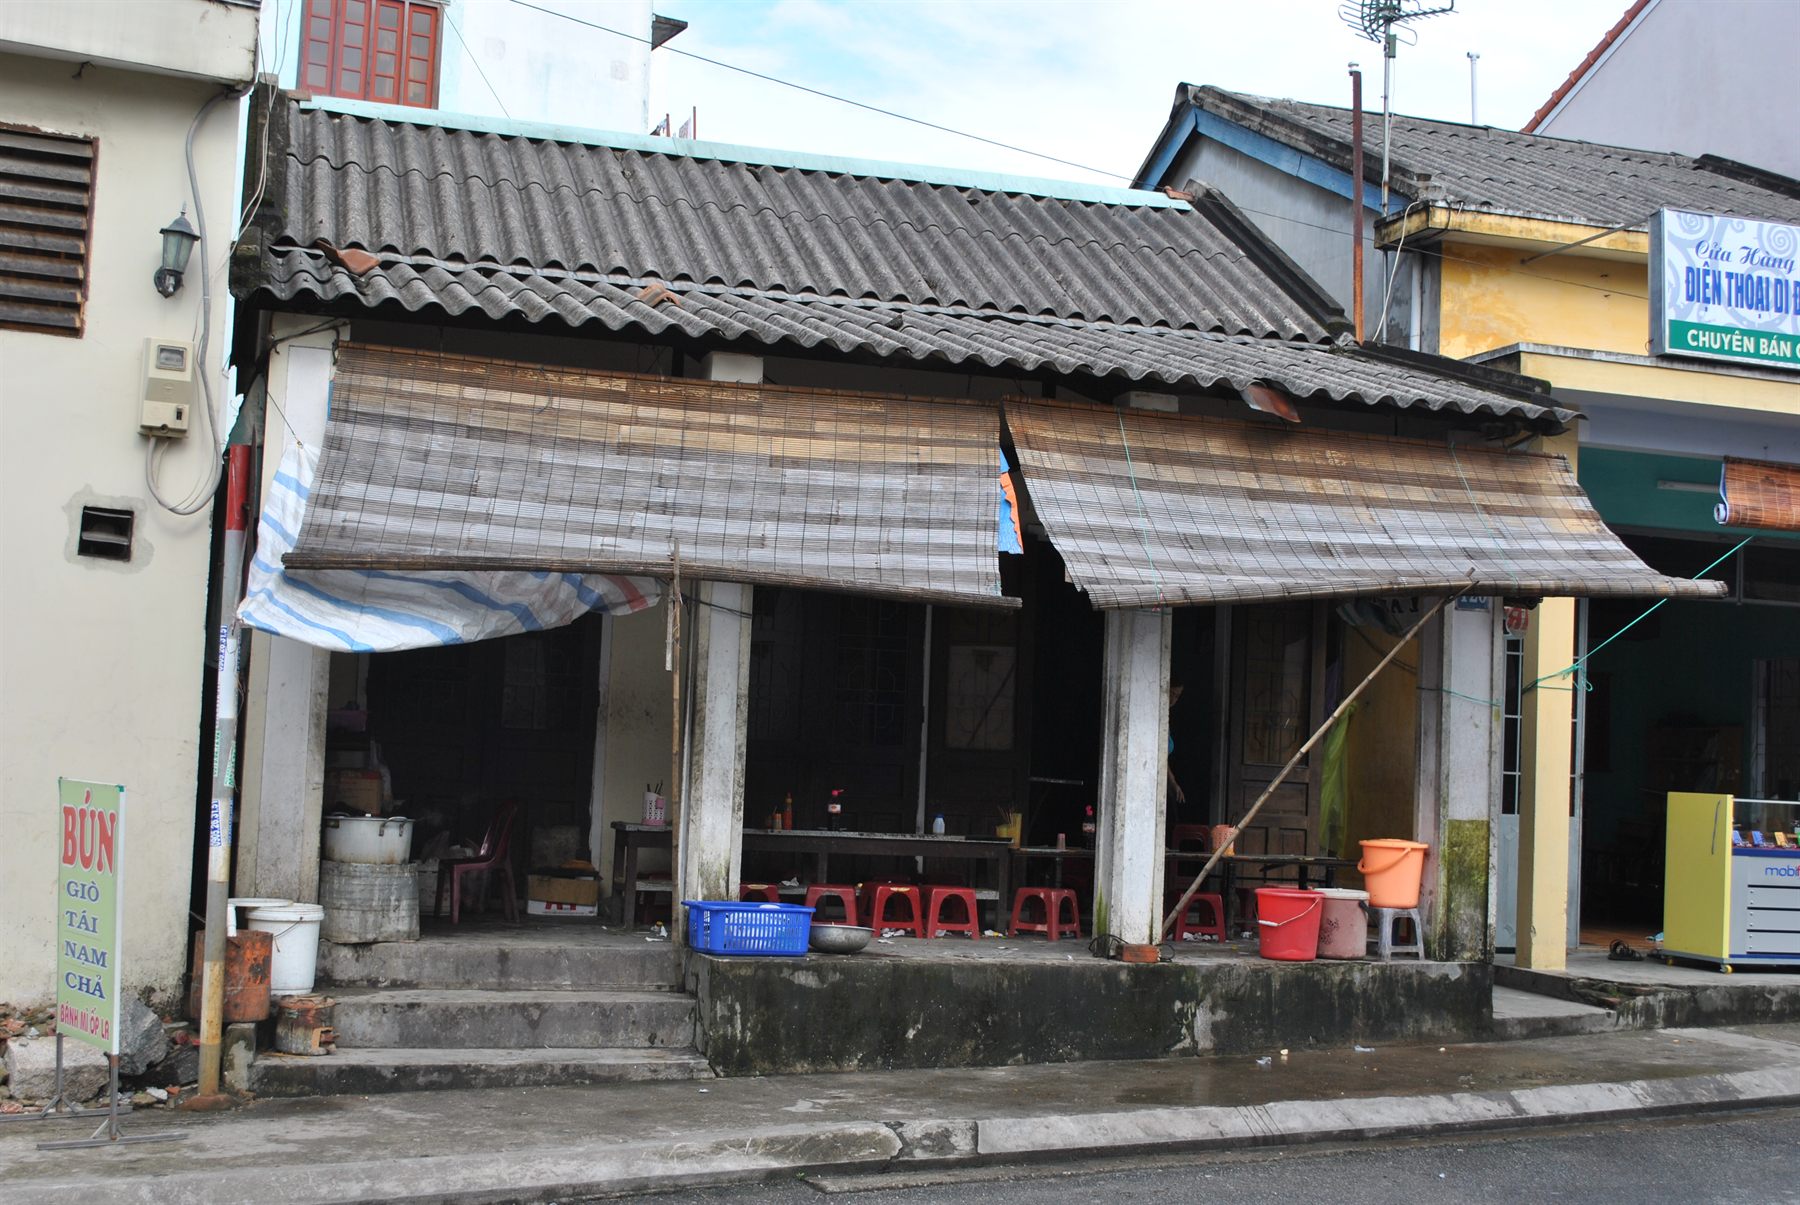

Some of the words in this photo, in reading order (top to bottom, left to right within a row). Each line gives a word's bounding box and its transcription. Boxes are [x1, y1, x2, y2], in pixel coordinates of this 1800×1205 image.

[1695, 240, 1732, 262] Cửa
[1739, 246, 1796, 275] Hàng
[1685, 261, 1721, 312] ĐIỆN
[1725, 271, 1770, 319] THOẠI
[1774, 278, 1789, 314] DI
[1687, 329, 1755, 353] CHUYÊN
[1759, 334, 1791, 358] BÁN
[62, 789, 117, 874] BÚN
[66, 880, 100, 902] GIÒ
[65, 910, 98, 933] TÁI
[64, 940, 107, 968] NẠM
[65, 972, 105, 999] CHẢ
[61, 1001, 79, 1027] BÁNH
